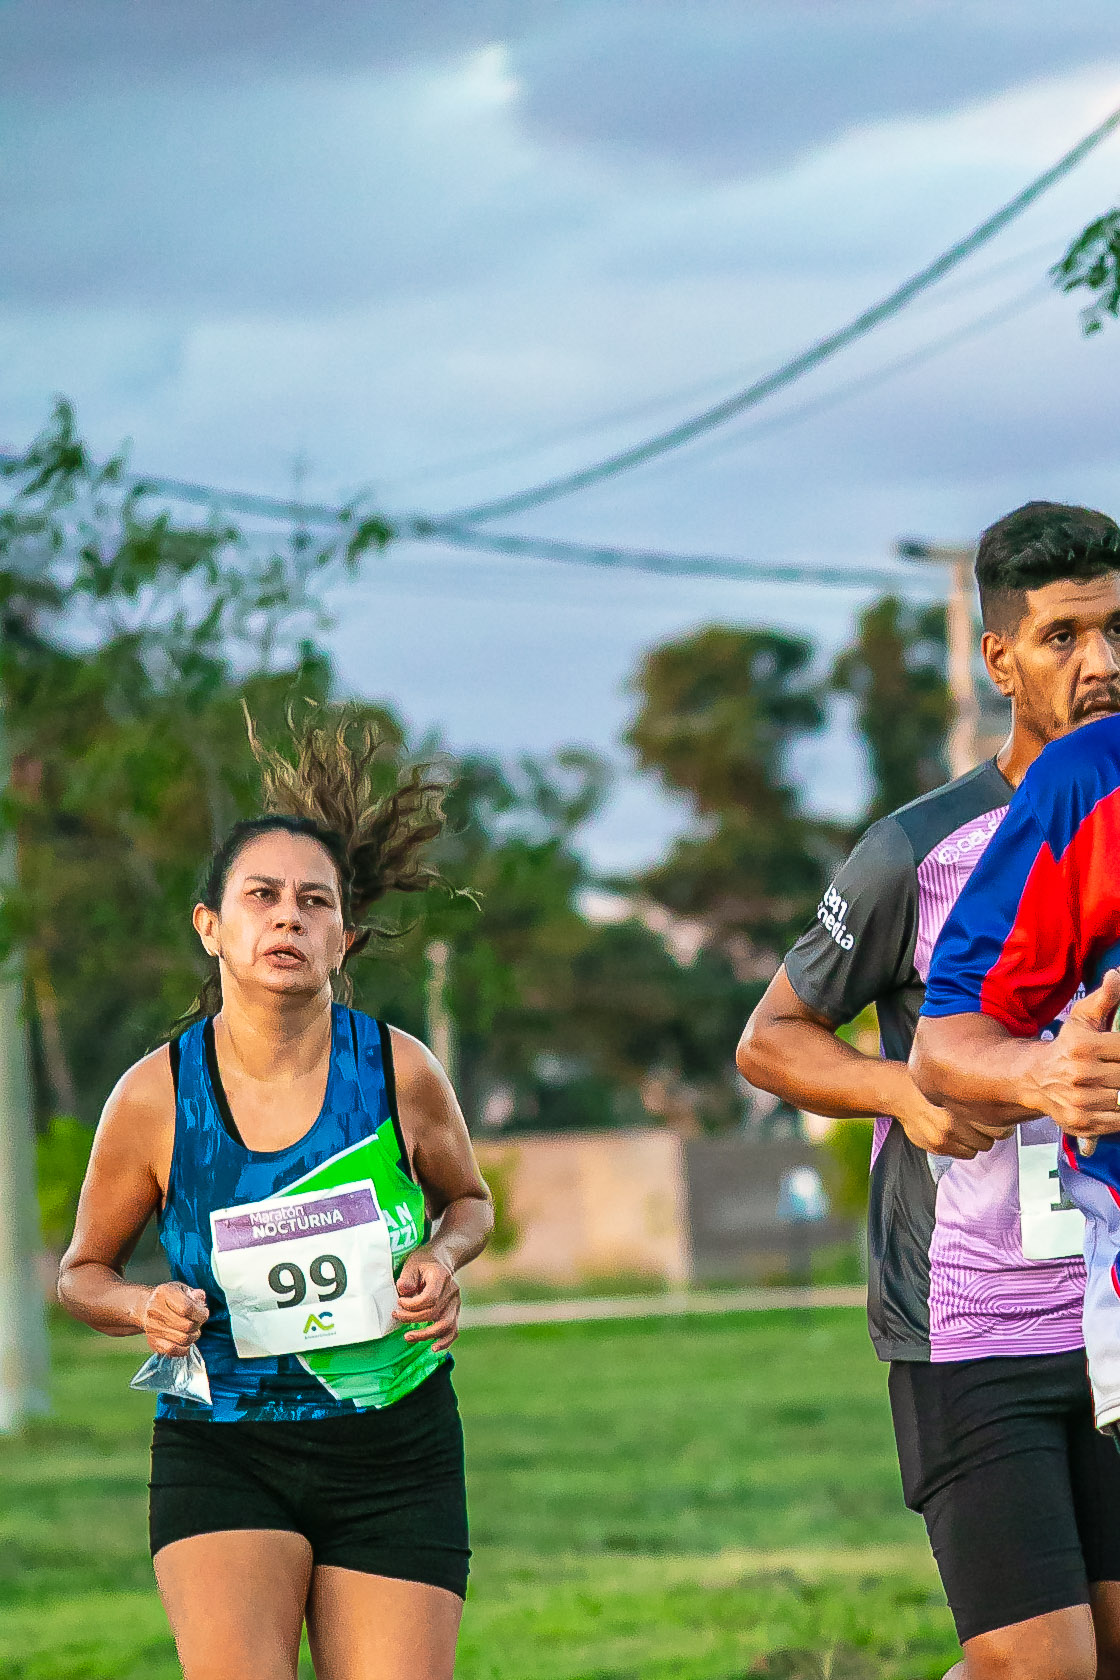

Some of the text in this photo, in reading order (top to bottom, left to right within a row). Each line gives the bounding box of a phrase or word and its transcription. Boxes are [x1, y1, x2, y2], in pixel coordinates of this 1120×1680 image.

[250, 1205, 304, 1225] Maratón
[252, 1208, 344, 1238] NOCTURNA
[268, 1253, 348, 1309] 99
